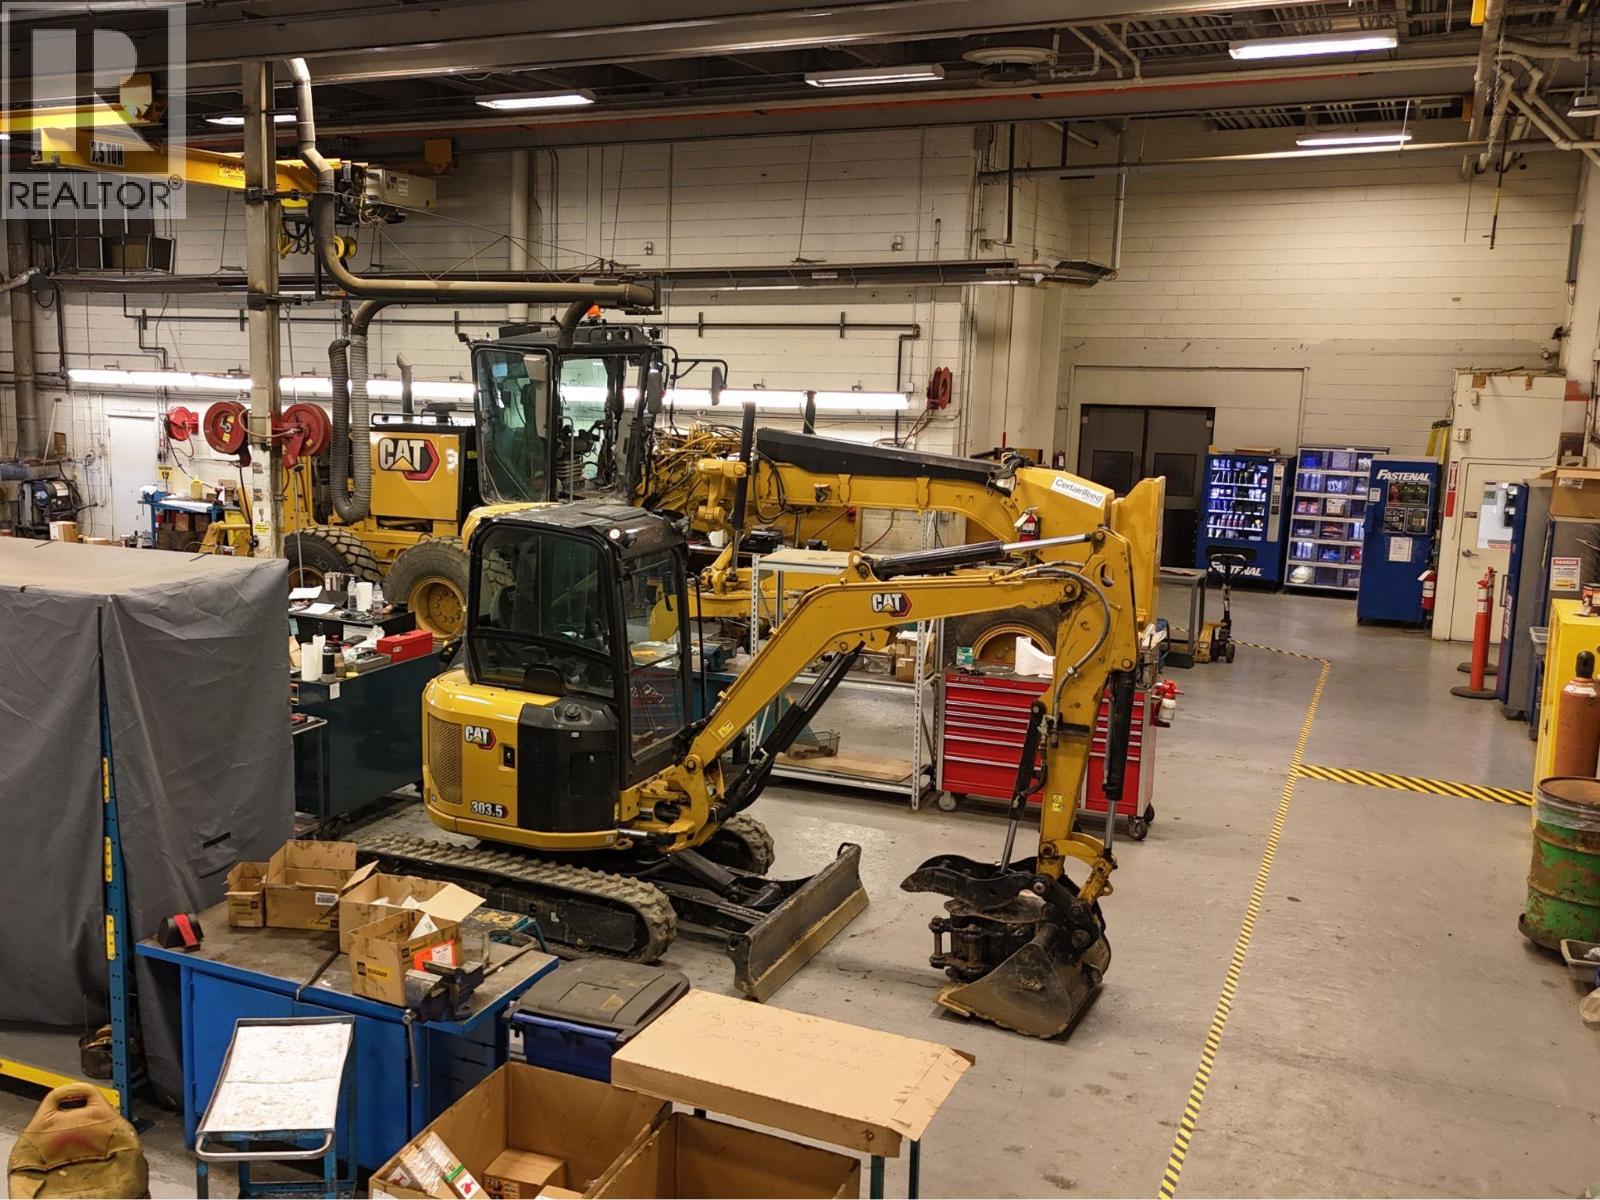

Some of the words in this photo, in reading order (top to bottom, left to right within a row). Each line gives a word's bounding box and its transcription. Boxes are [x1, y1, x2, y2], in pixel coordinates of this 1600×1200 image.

[91, 141, 105, 163] 7.5
[106, 143, 124, 166] TON
[379, 438, 425, 471] CAT
[1376, 469, 1430, 481] FASTENAL
[872, 593, 902, 612] CAT
[465, 725, 489, 745] CAT
[471, 801, 503, 818] 303.5
